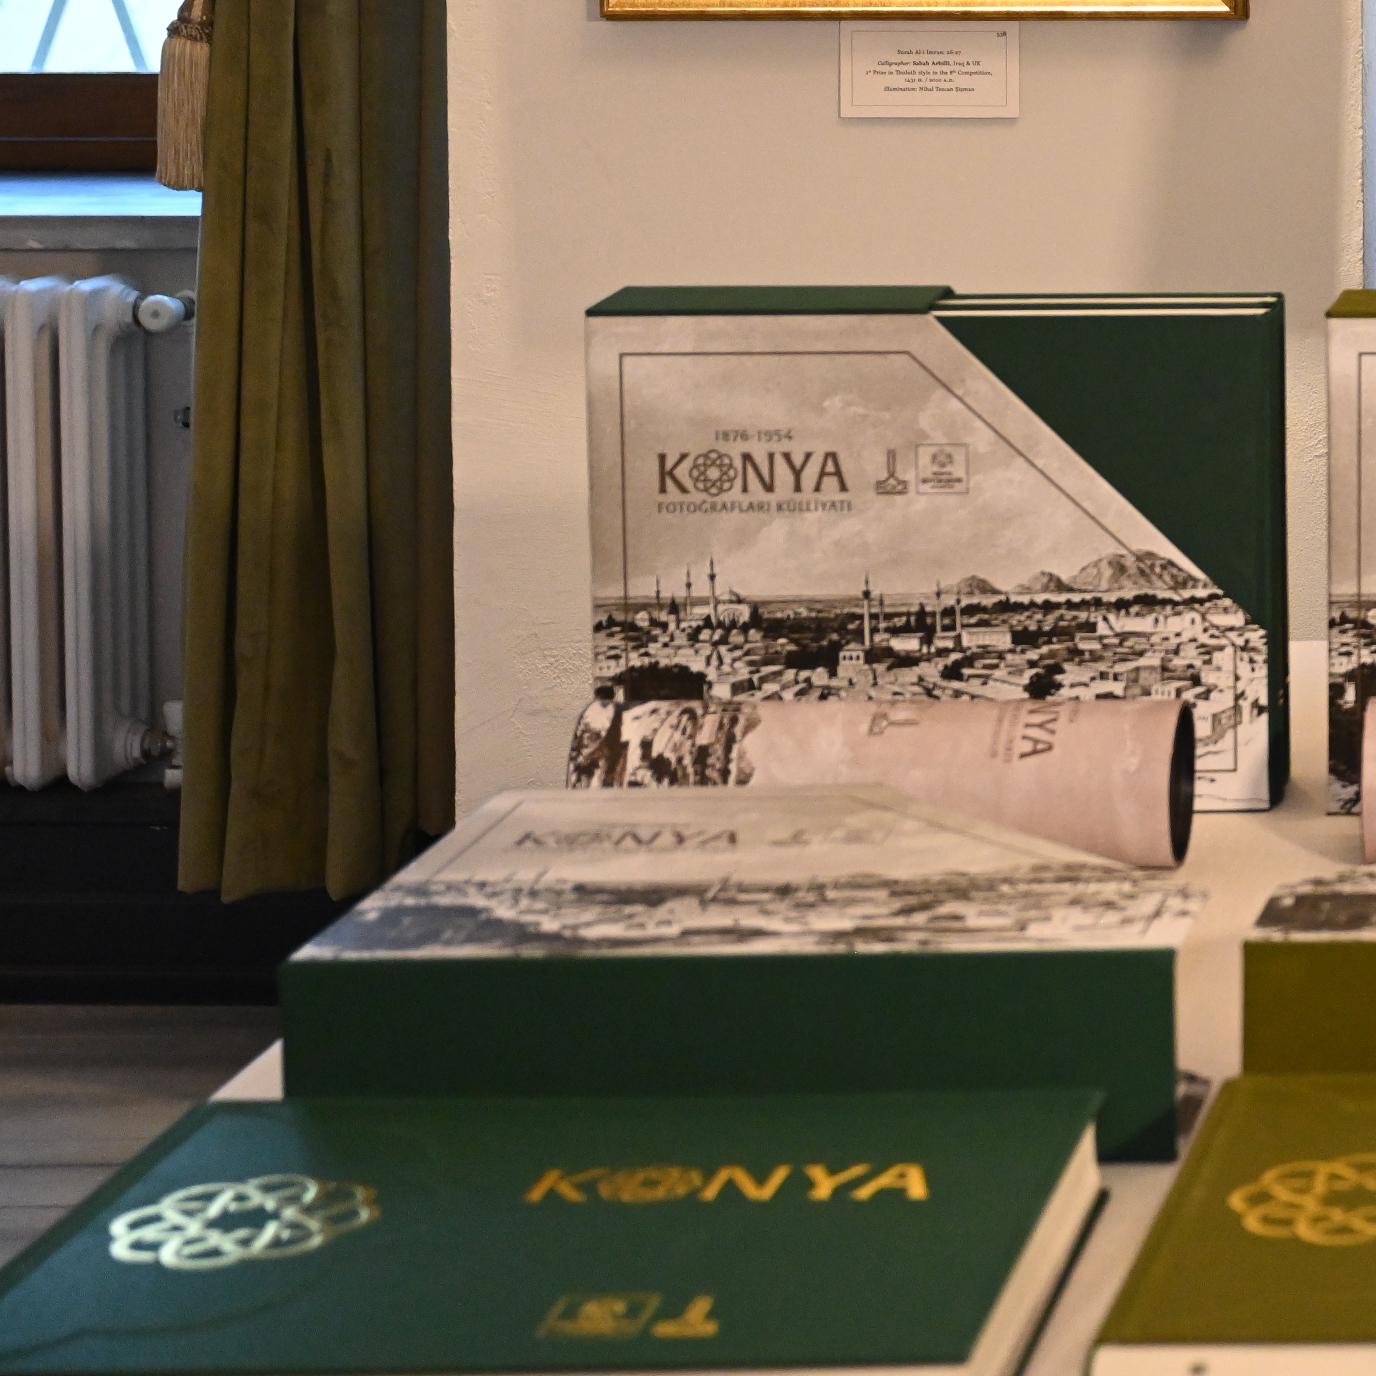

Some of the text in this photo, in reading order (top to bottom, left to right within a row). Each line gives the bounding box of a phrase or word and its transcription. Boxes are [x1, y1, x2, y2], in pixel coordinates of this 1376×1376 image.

[715, 429, 793, 442] 1876-1954
[657, 449, 849, 497] KONYA
[524, 1163, 932, 1204] KONYA
